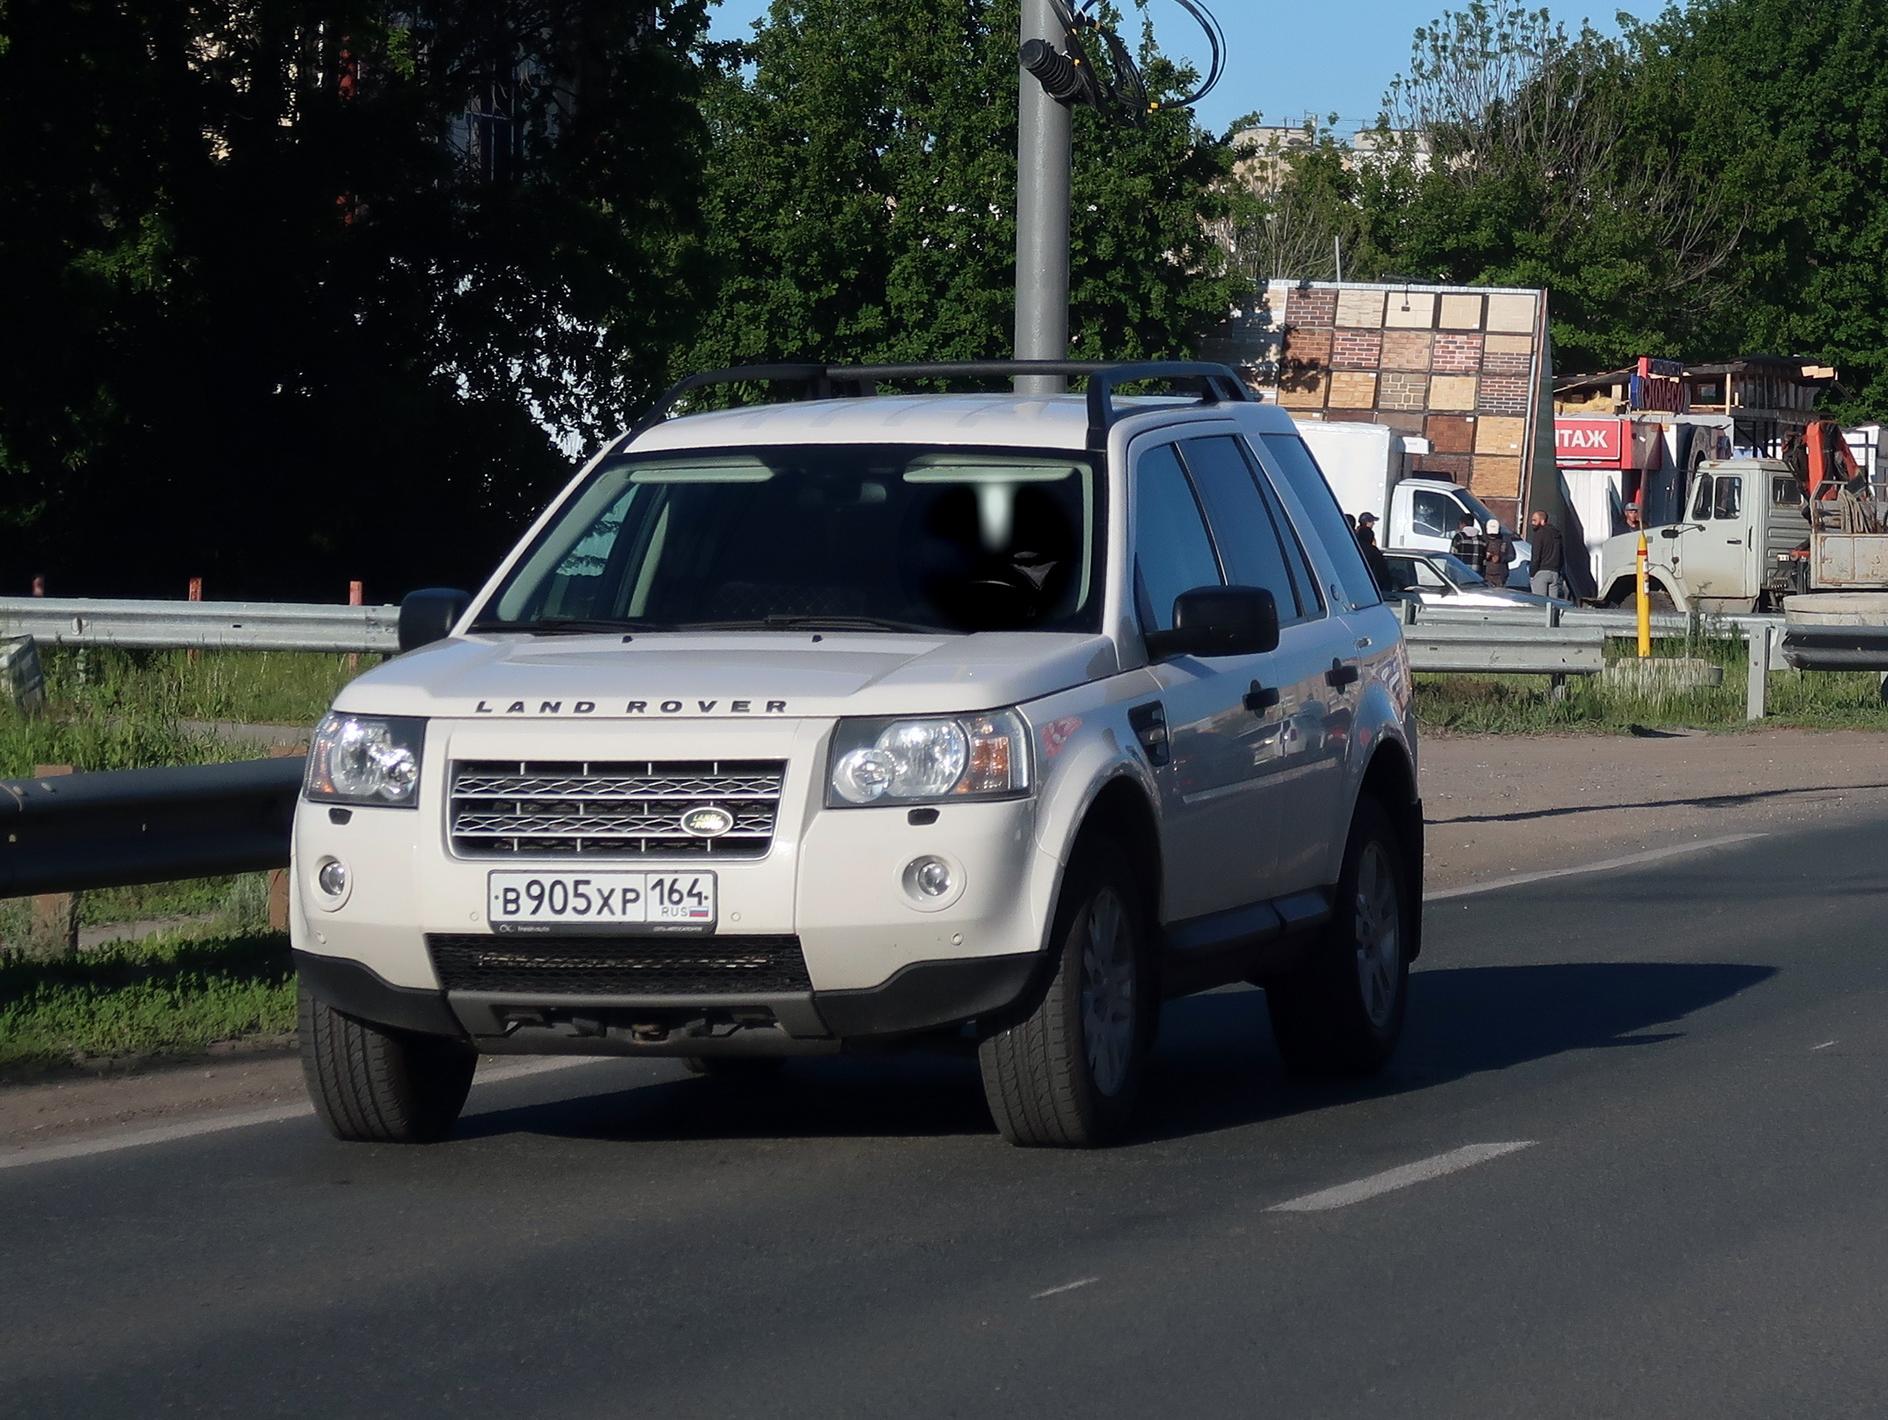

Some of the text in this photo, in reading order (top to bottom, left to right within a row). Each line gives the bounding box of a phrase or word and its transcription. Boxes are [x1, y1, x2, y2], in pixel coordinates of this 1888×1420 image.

[475, 700, 788, 714] LAND ROVER
[650, 878, 704, 906] 164
[661, 906, 688, 917] RUS
